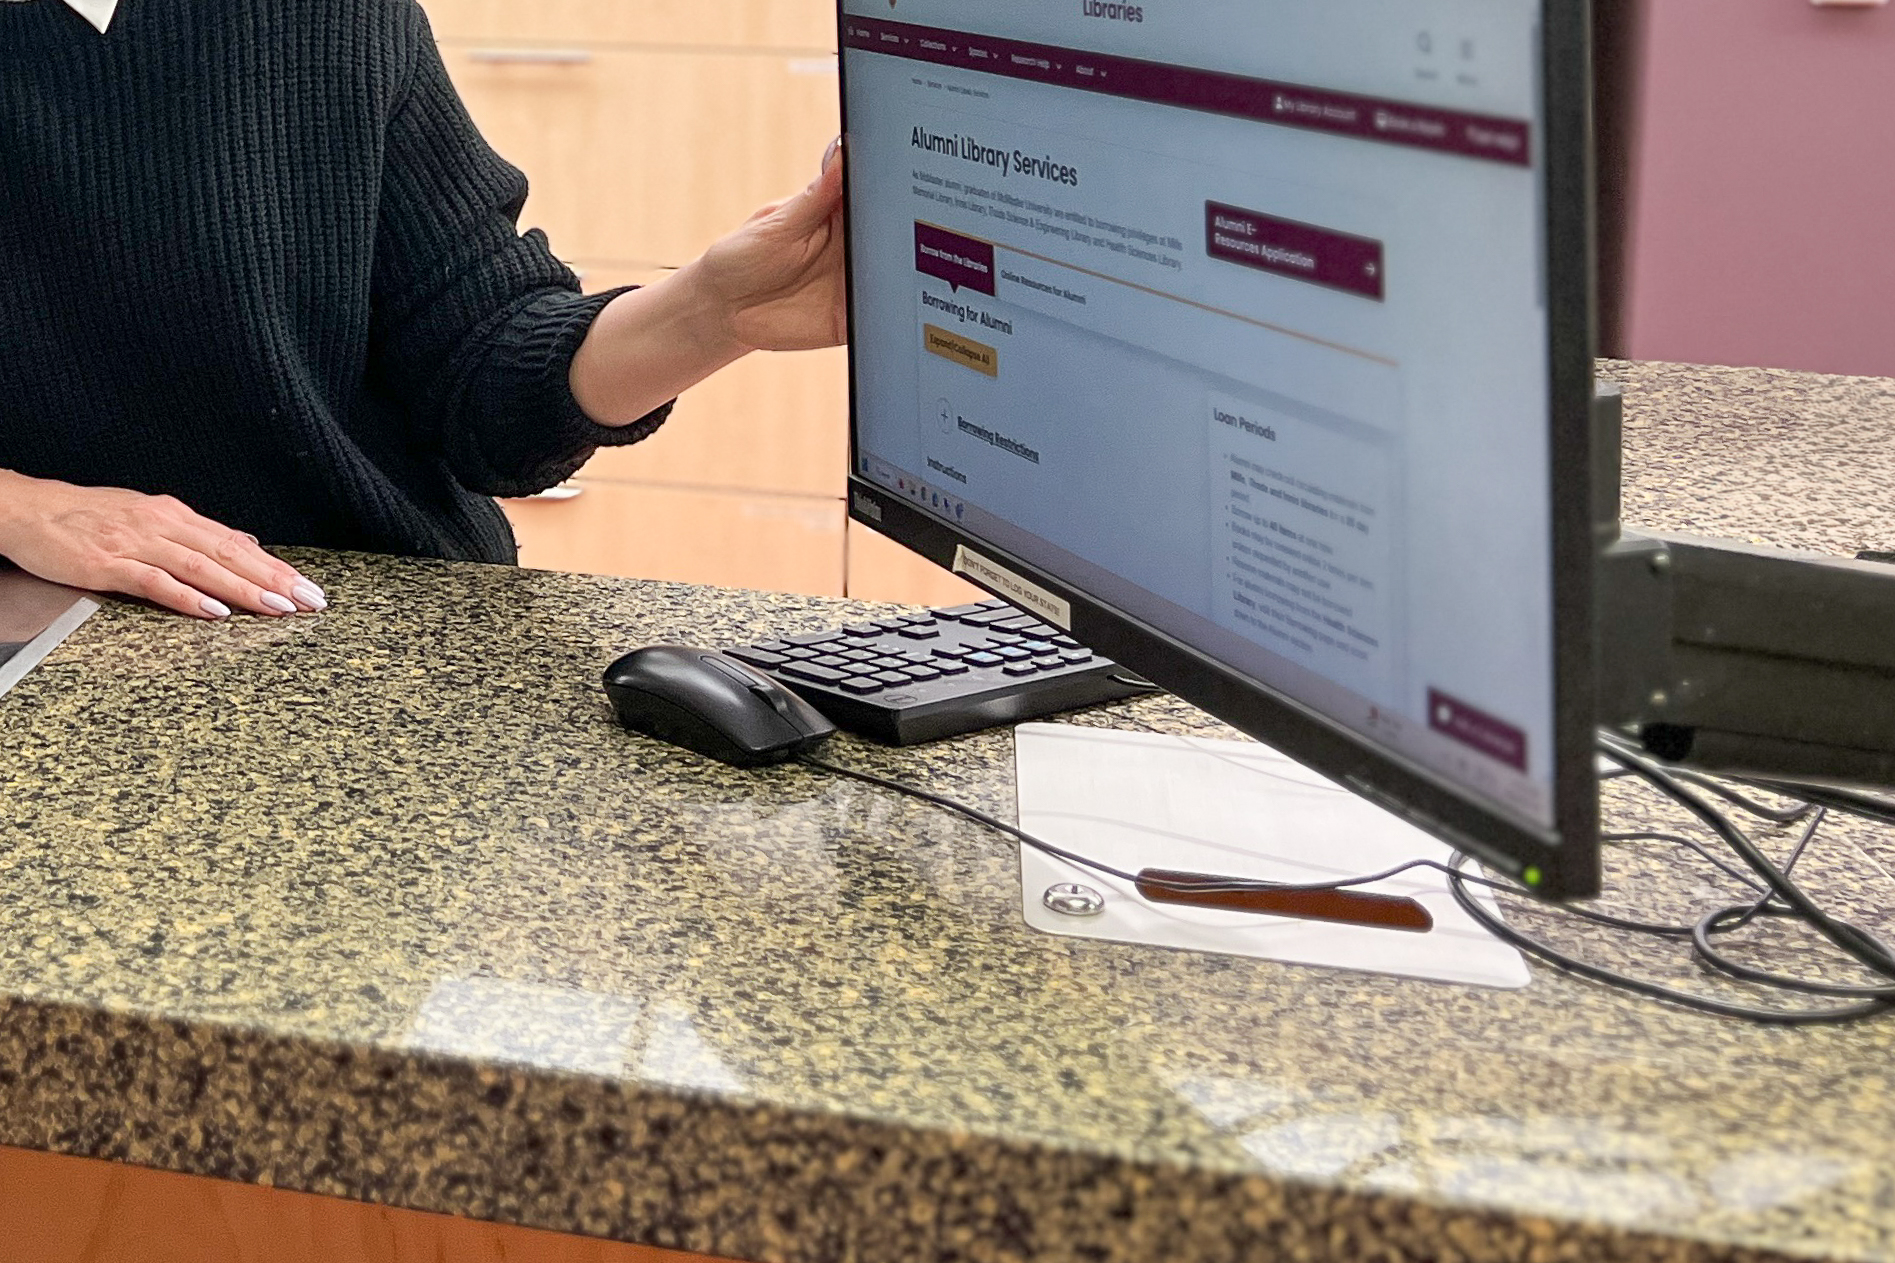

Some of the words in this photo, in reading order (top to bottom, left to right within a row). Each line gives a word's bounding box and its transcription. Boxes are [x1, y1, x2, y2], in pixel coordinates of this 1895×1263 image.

[911, 126, 958, 158] Alumni
[960, 136, 1010, 177] Library
[1012, 150, 1078, 186] Services
[1214, 216, 1246, 233] Alumni
[1246, 223, 1257, 236] E-
[920, 243, 939, 258] Borrow
[940, 250, 952, 261] from
[953, 253, 962, 265] the
[964, 257, 988, 273] Libraries
[1214, 232, 1260, 255] Resources
[1260, 244, 1315, 268] Application
[1000, 269, 1020, 283] Online
[1020, 275, 1052, 294] Resources
[1052, 285, 1062, 296] for
[1063, 287, 1086, 305] Alumni
[922, 290, 965, 322] Borrowing
[966, 305, 978, 322] for
[980, 312, 1013, 336] Alumni
[958, 416, 994, 446] Borrowing
[995, 432, 1040, 463] Restrictions
[1213, 408, 1238, 428] Loan
[1239, 416, 1276, 442] Periods
[926, 456, 967, 484] Instructions
[980, 566, 1001, 583] FORGET
[1002, 577, 1010, 588] TO
[1010, 582, 1022, 595] LOG
[1024, 588, 1038, 604] YOUR
